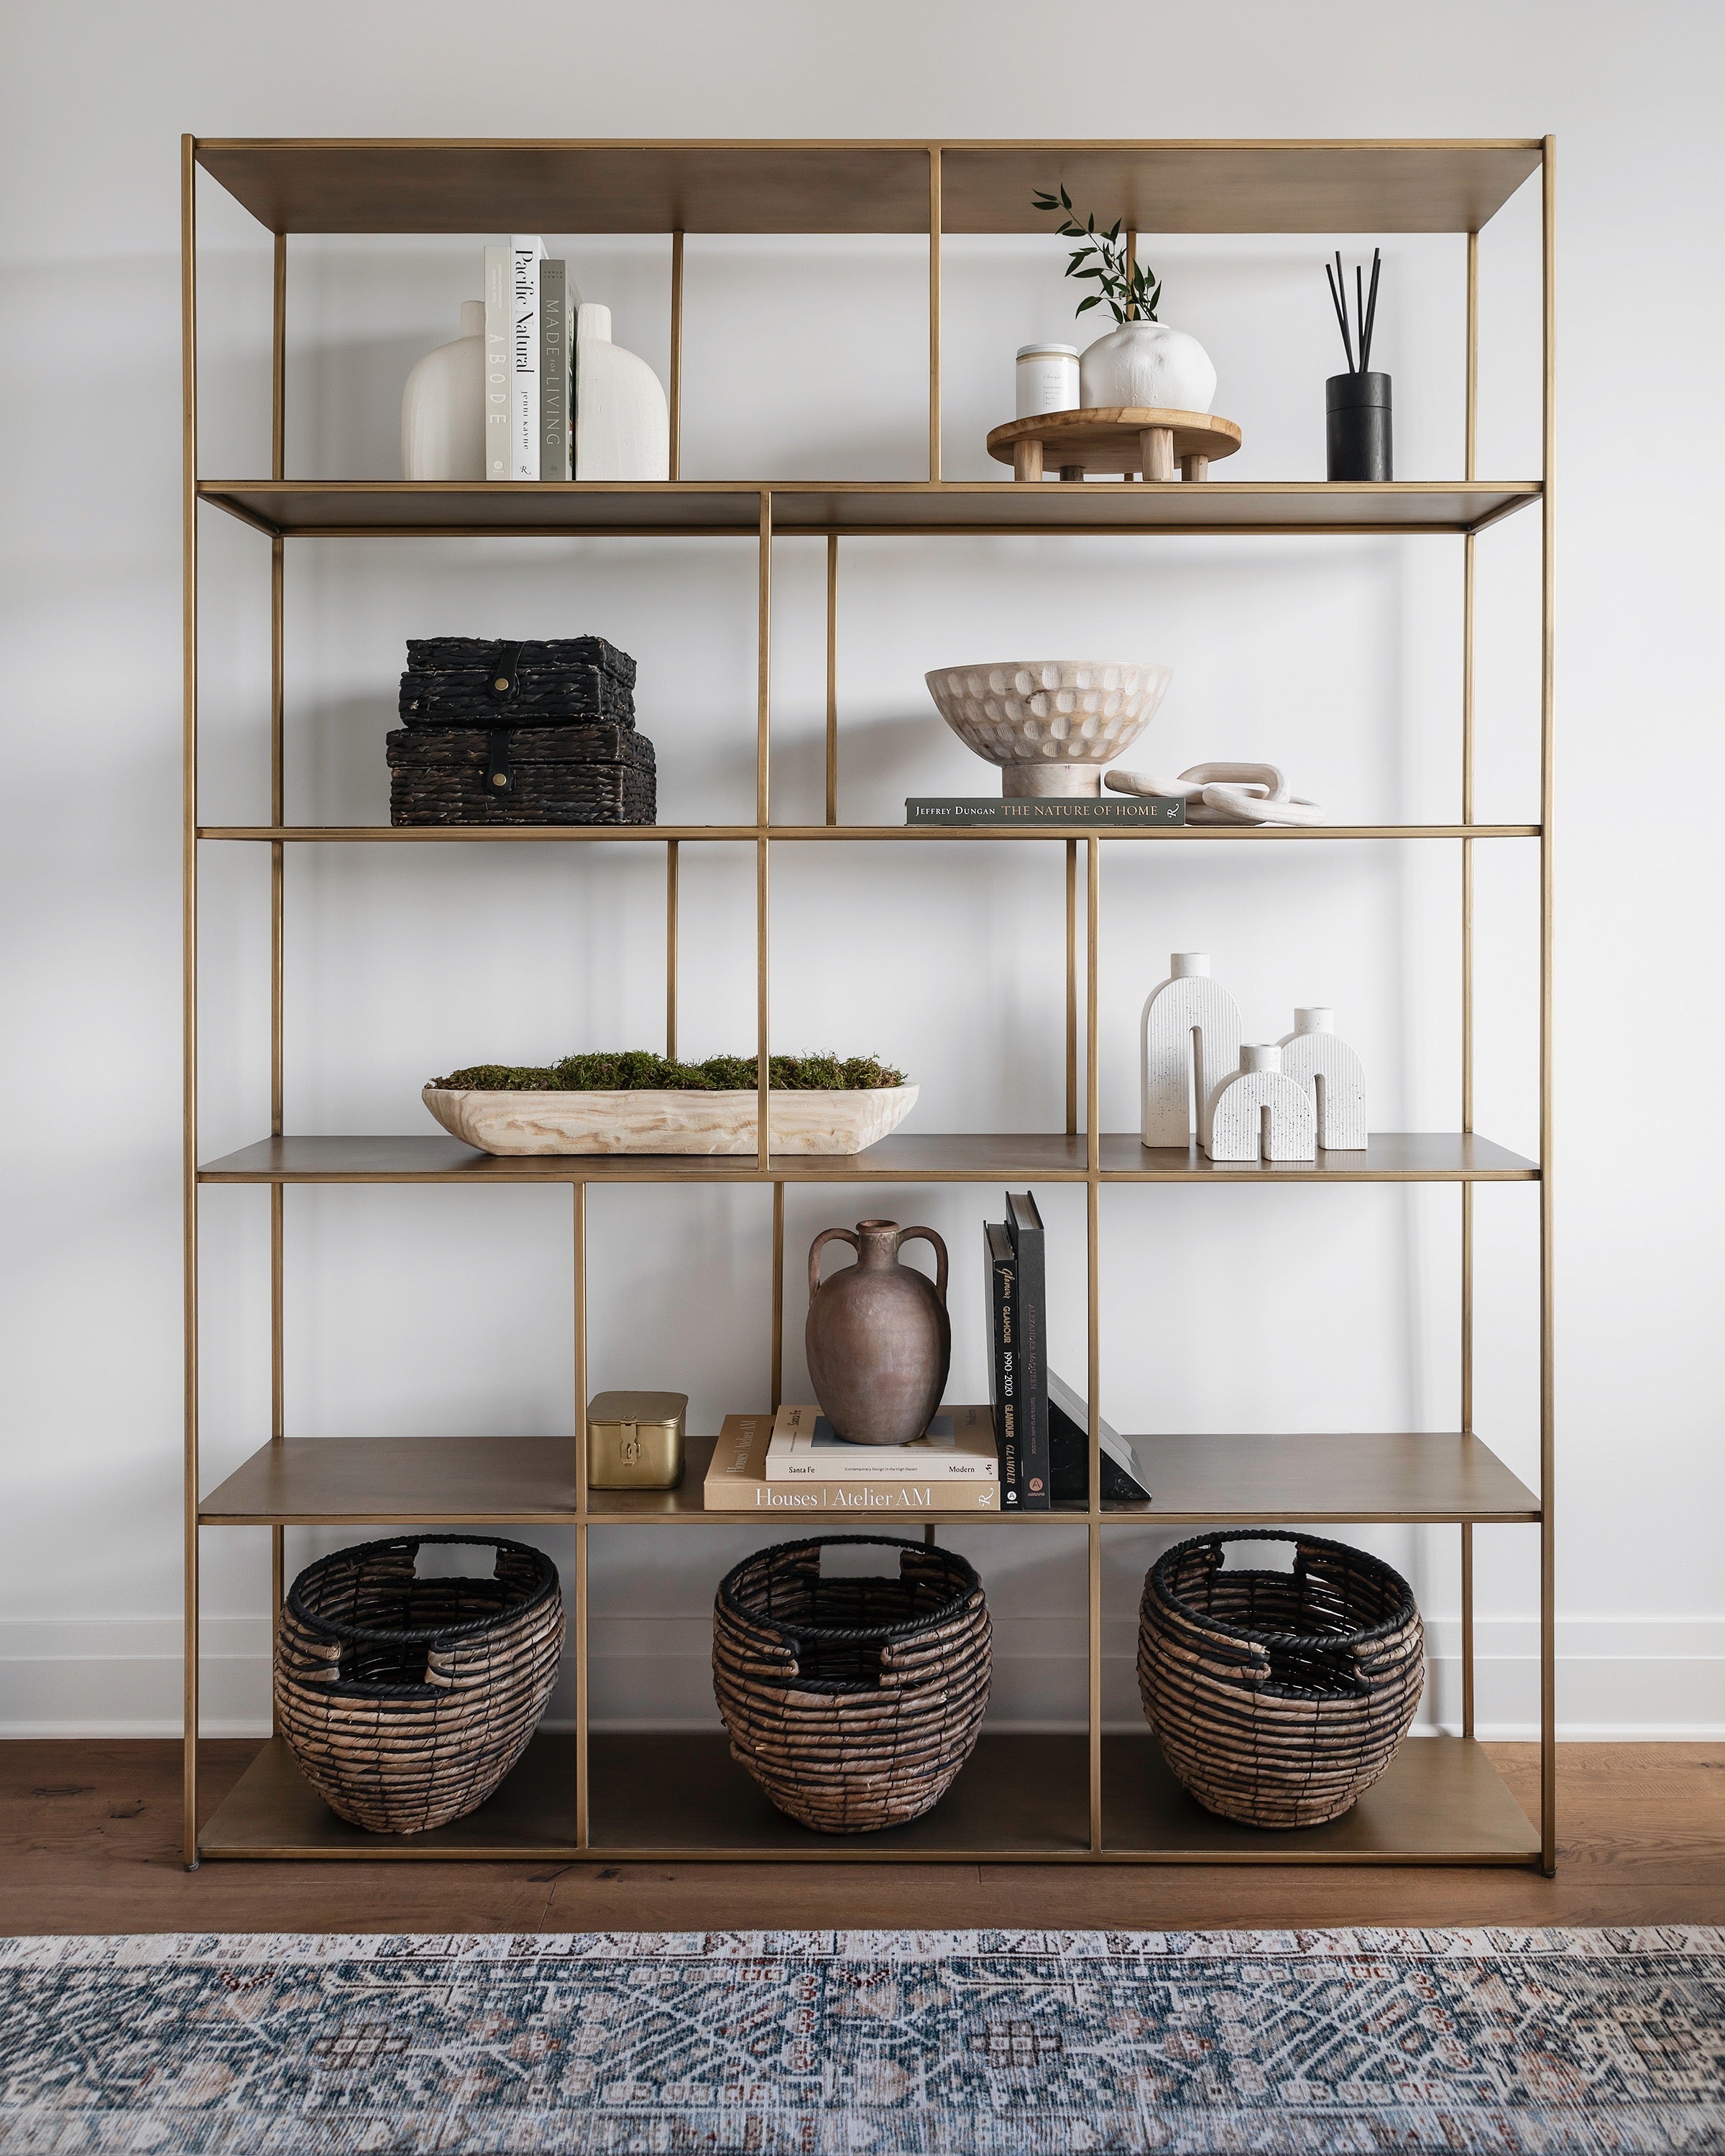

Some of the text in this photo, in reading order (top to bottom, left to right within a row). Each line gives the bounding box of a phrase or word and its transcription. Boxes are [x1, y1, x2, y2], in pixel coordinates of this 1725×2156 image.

[515, 249, 535, 373] Pacific Natural
[546, 300, 560, 356] MADE
[489, 333, 507, 424] ABODE
[546, 377, 560, 446] LIVING
[1001, 806, 1030, 816] THE
[1035, 806, 1090, 816] NATURE
[1094, 806, 1112, 816] OF
[1116, 806, 1158, 816] HOME
[1003, 1305, 1011, 1344] GLAMOUR
[1003, 1351, 1013, 1396] 1990-2020
[740, 1419, 757, 1431] AM
[1005, 1404, 1014, 1438] GLAMOUR
[735, 1432, 754, 1450] Atelier
[726, 1452, 748, 1473] Houses
[1006, 1445, 1016, 1485] GLAMOUR
[755, 1488, 818, 1506] Houses
[832, 1488, 893, 1506] Atelier
[896, 1488, 932, 1506] AM
